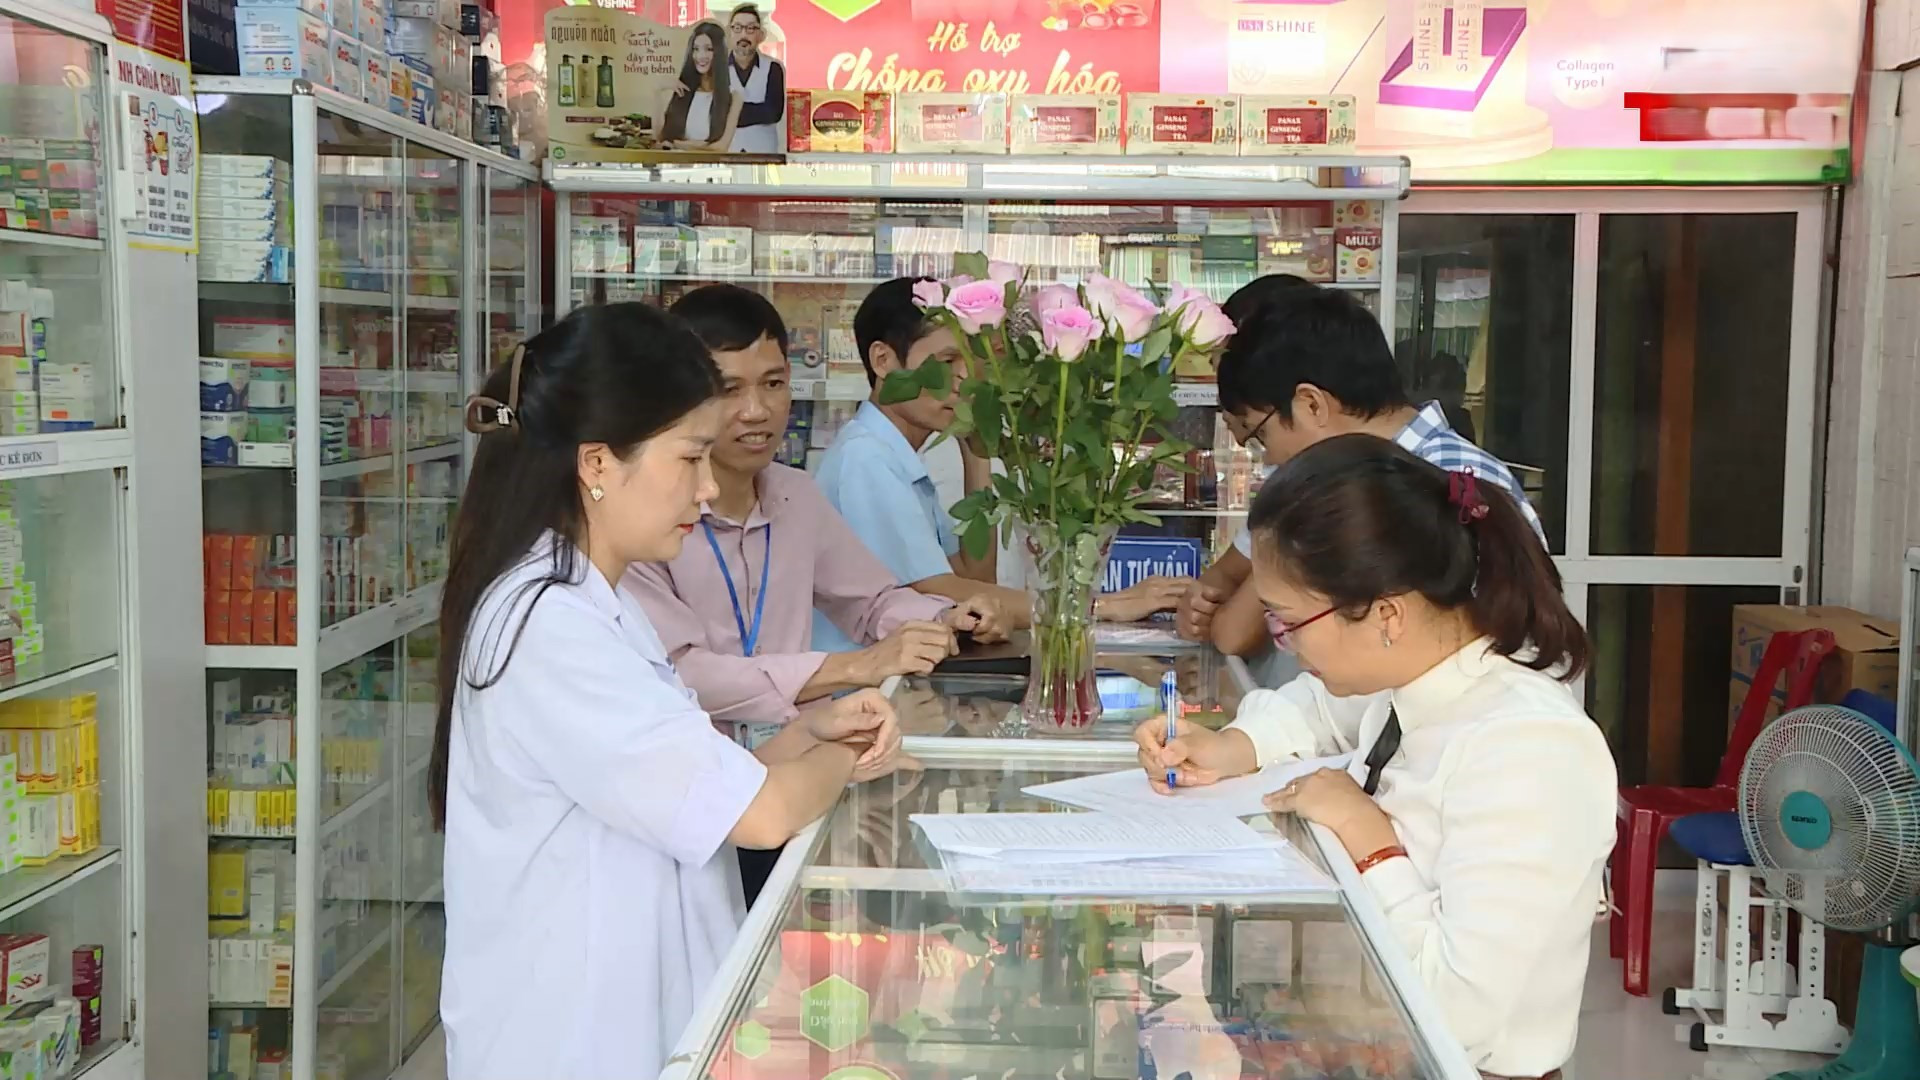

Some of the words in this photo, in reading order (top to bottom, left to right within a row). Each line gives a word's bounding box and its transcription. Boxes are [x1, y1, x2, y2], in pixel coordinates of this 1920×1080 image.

[1267, 20, 1316, 33] SHINE
[979, 20, 1021, 57] trợ
[1418, 17, 1431, 71] SHINE
[1456, 18, 1470, 72] SHINE
[1045, 49, 1121, 94] hóa
[1556, 60, 1615, 74] Collagen
[1566, 76, 1598, 89] Type
[1163, 115, 1187, 123] PANAX
[1156, 124, 1187, 132] GINSENG
[1172, 133, 1187, 141] TEA
